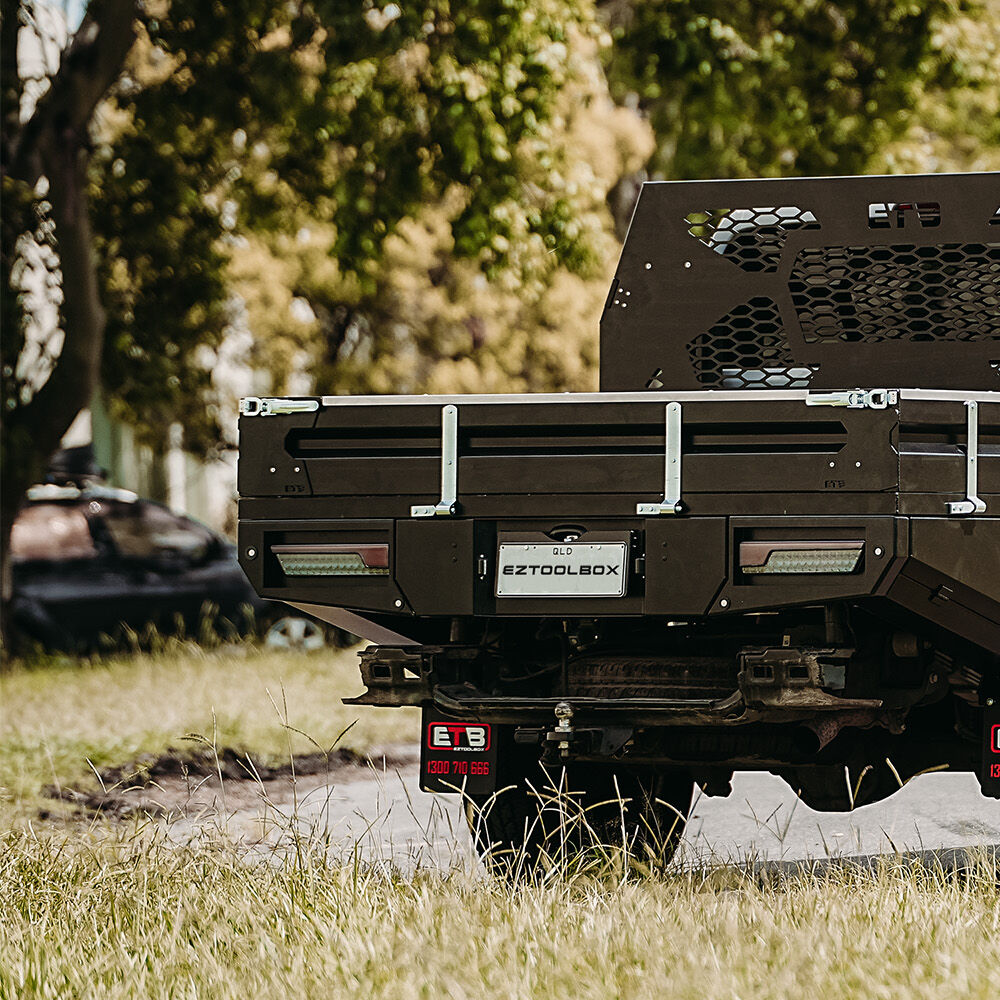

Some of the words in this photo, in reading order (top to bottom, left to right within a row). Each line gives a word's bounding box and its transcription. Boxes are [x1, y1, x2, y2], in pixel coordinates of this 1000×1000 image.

[868, 202, 941, 229] ETB
[552, 547, 573, 556] QLD
[502, 564, 620, 576] EZTOOLBOX
[433, 726, 486, 747] ETB
[427, 760, 450, 775] 1300
[452, 760, 468, 775] 710
[471, 761, 490, 775] 666
